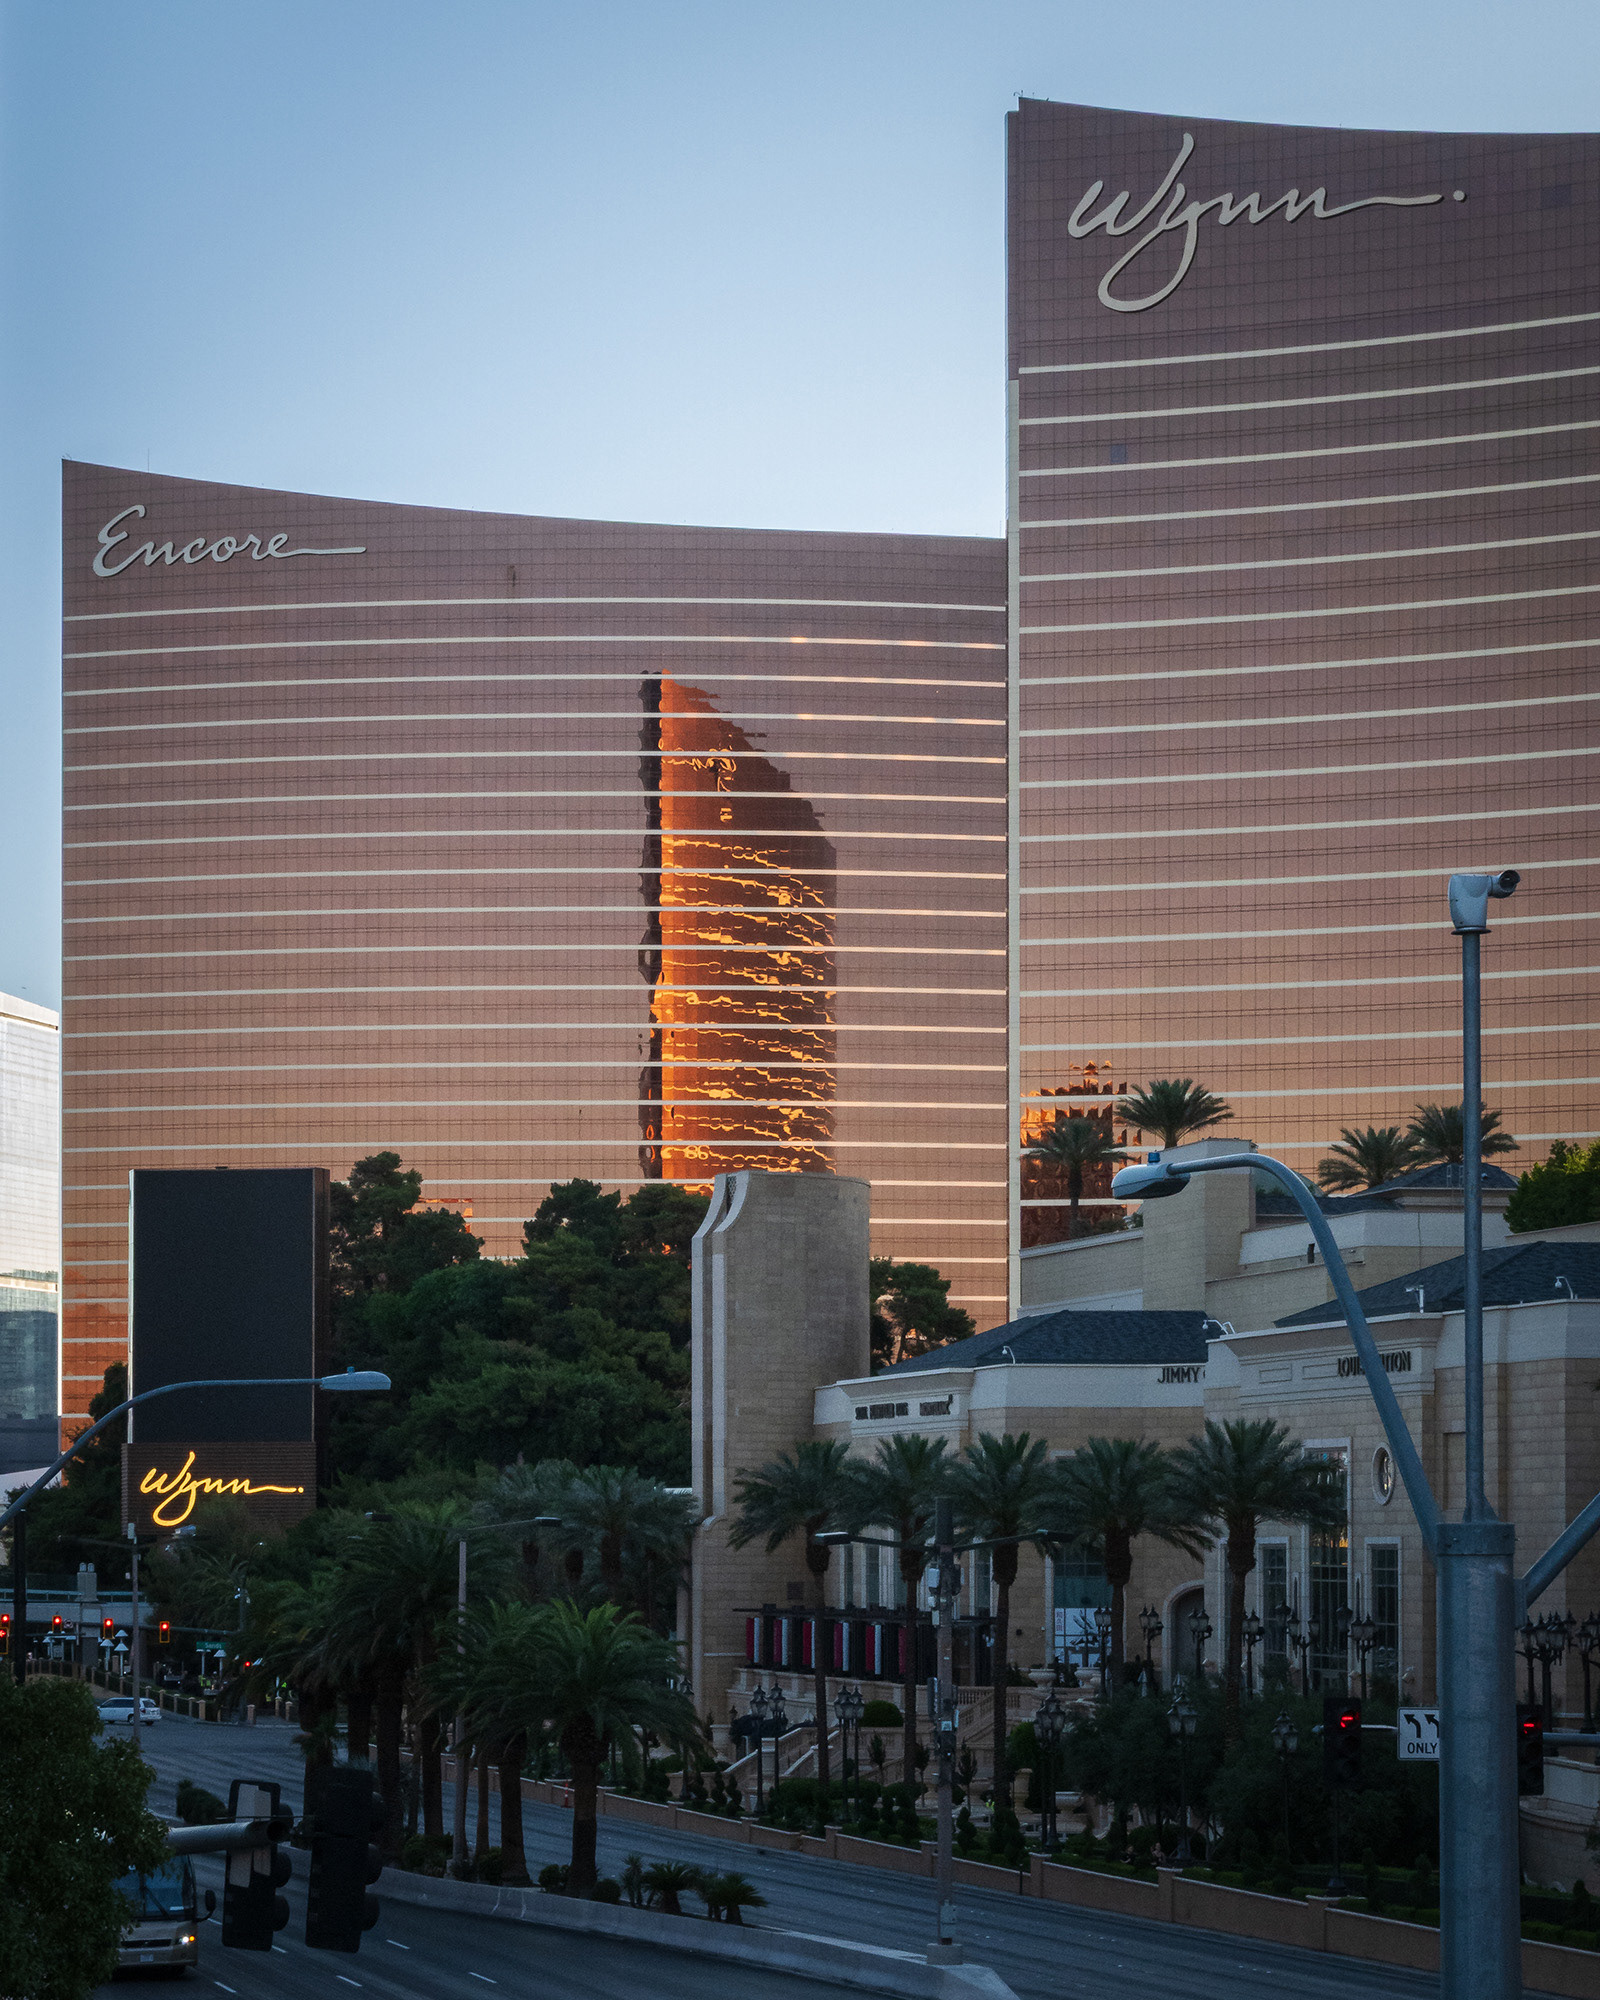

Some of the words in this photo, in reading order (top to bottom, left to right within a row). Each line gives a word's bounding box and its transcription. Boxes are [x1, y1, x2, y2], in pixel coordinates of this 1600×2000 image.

[92, 504, 367, 577] Encore
[1157, 1367, 1201, 1384] JIMMY
[1407, 1742, 1438, 1754] ONLY
